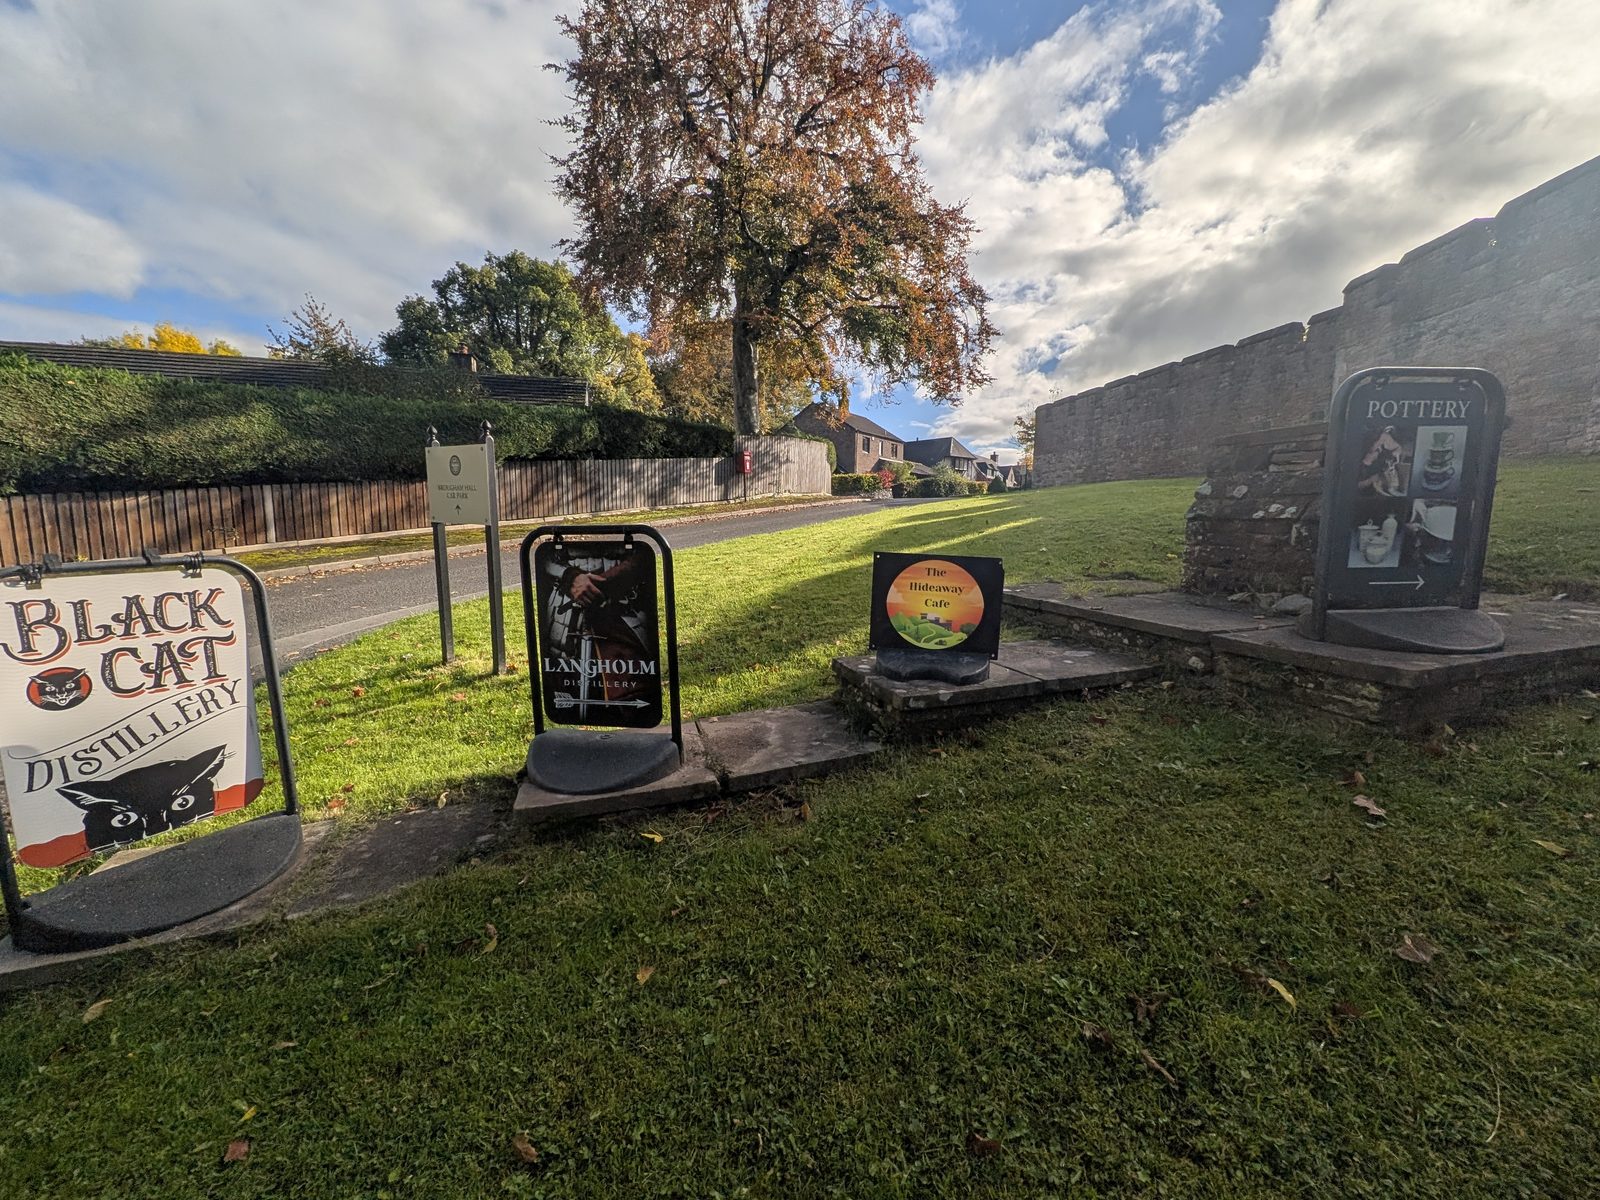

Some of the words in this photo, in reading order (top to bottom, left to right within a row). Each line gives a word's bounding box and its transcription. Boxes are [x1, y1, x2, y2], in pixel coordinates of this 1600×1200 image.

[1366, 399, 1472, 419] POTTERY
[925, 567, 947, 577] The
[909, 582, 965, 596] Hideaway
[924, 598, 950, 609] Cafe
[0, 588, 234, 665] BLACK
[100, 630, 237, 698] CAT
[543, 657, 657, 678] LANGHOLM
[563, 679, 637, 689] DISTILLERY
[24, 678, 242, 794] DISTILLERY
